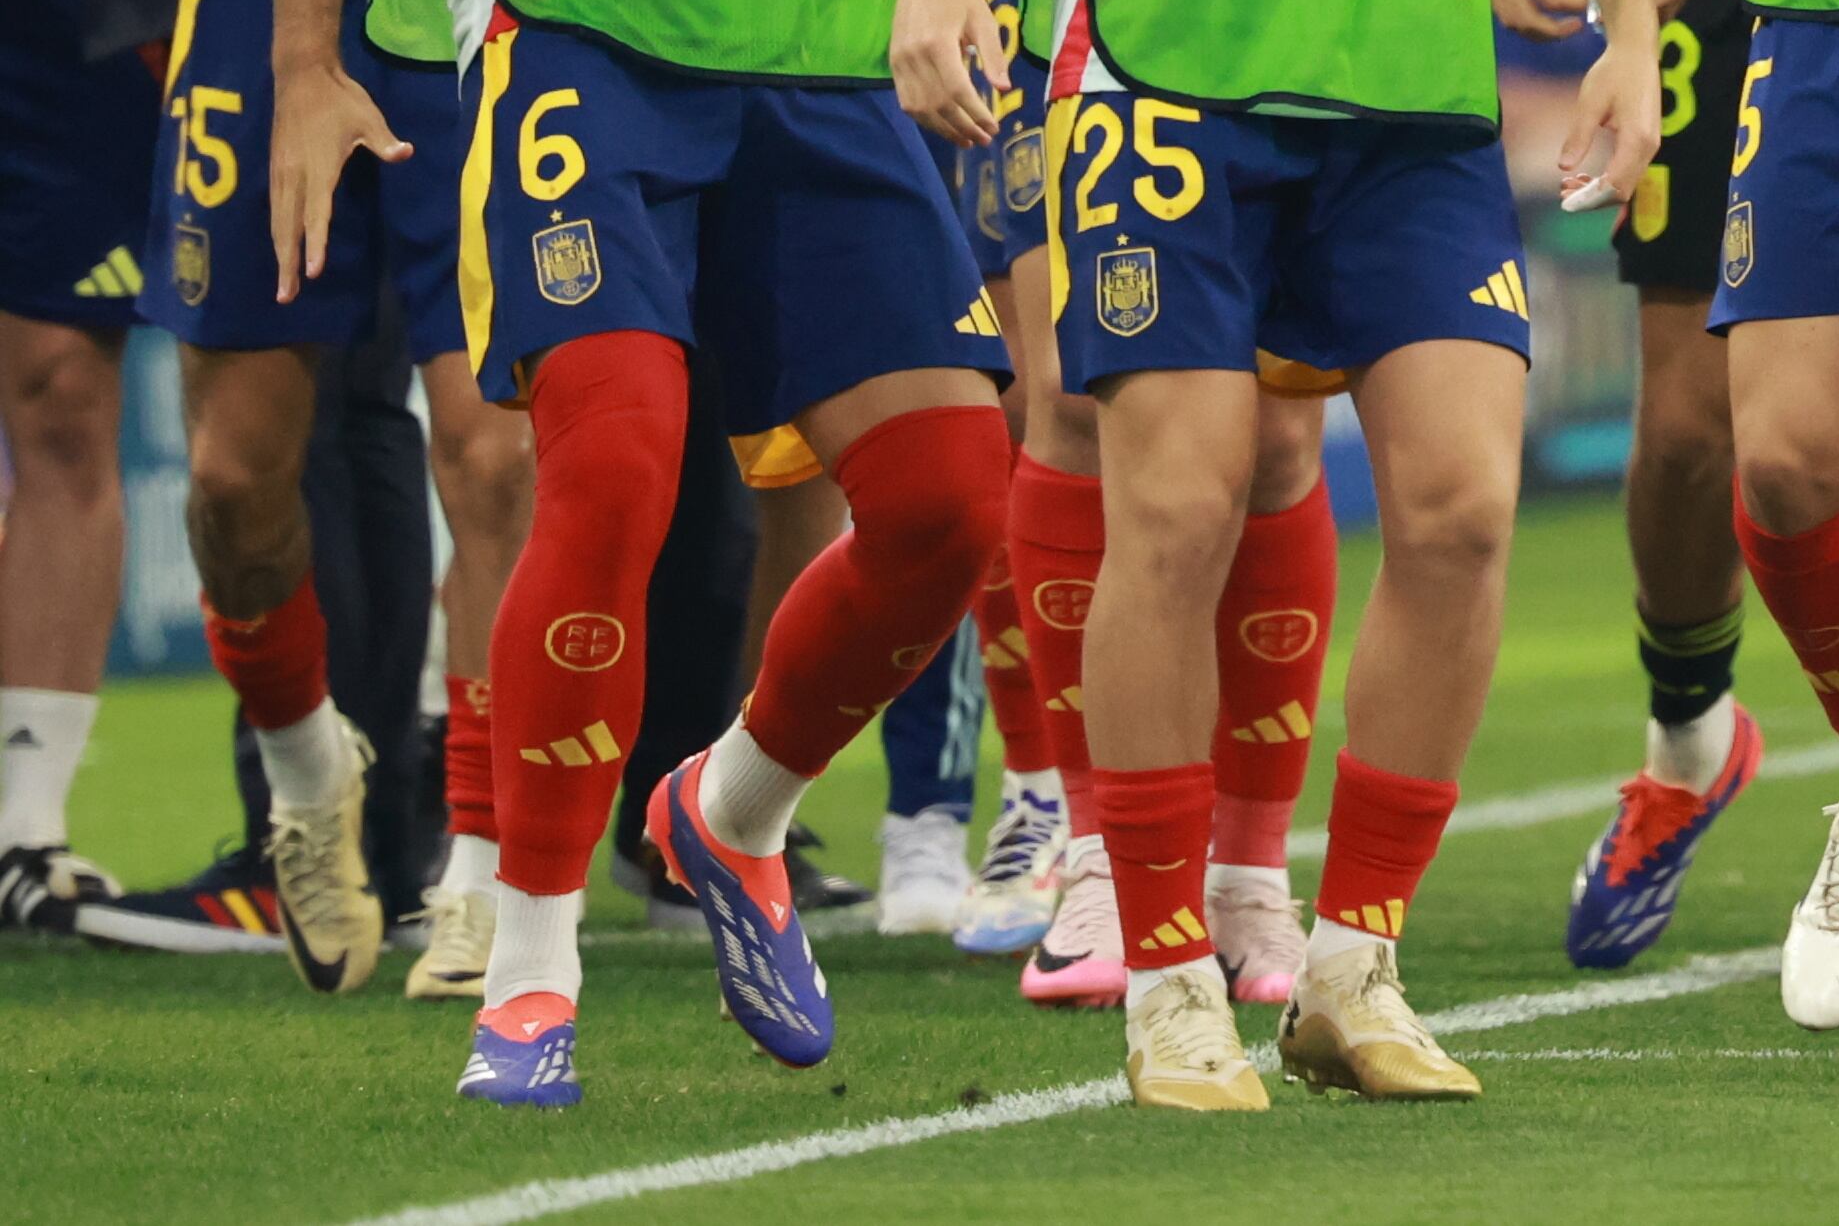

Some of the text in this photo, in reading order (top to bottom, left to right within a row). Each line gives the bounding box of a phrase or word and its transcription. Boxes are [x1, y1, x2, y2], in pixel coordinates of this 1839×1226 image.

[171, 85, 242, 209] 15
[518, 88, 586, 201] 6
[1072, 98, 1205, 234] 25
